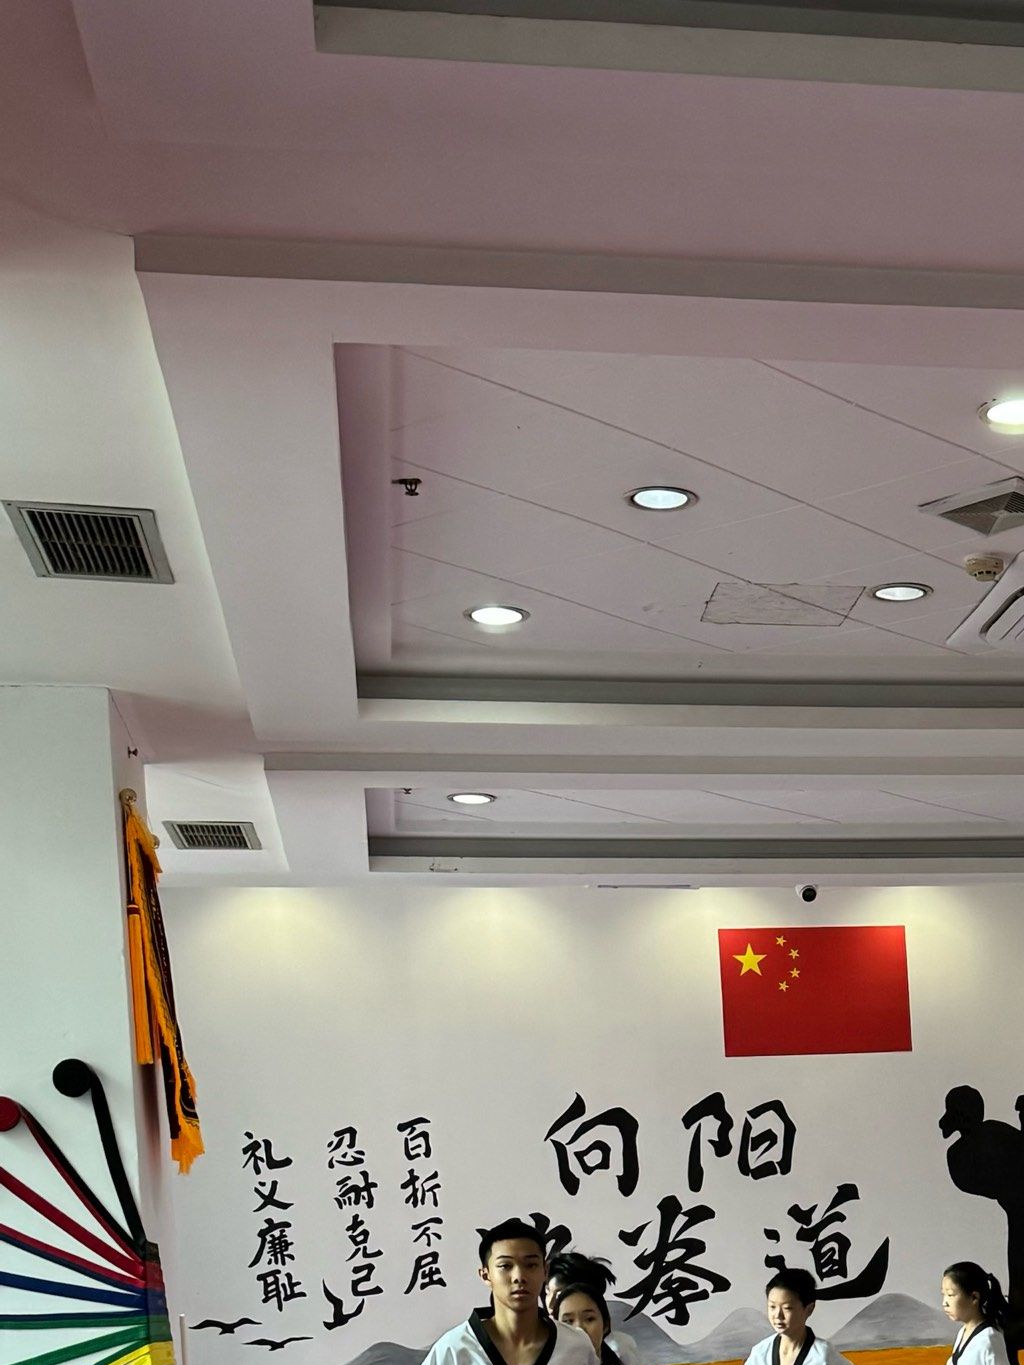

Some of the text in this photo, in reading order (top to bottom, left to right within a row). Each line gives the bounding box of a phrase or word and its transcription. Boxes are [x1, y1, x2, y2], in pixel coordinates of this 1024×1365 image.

[241, 1131, 307, 1312] 礼义廉耻
[327, 1126, 383, 1297] 忍耐克己
[397, 1117, 447, 1295] 百折不屈
[544, 1092, 796, 1197] 向阳
[476, 1183, 890, 1328] 拳道
